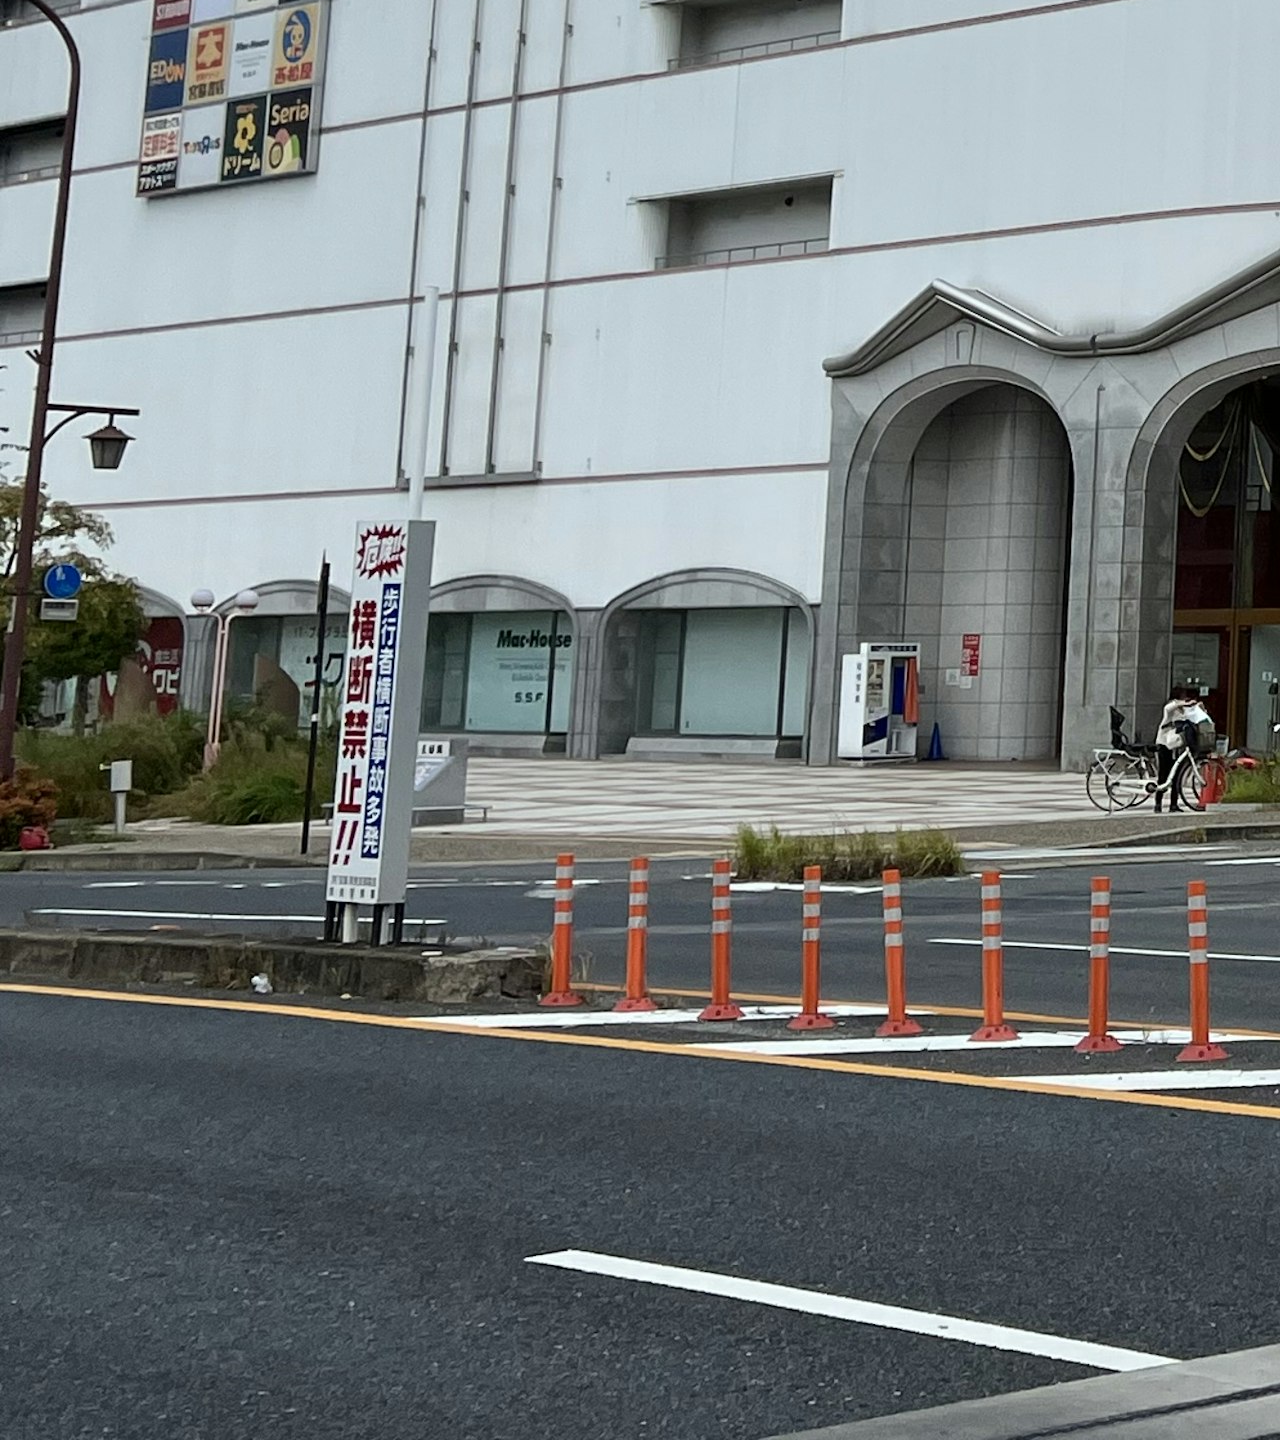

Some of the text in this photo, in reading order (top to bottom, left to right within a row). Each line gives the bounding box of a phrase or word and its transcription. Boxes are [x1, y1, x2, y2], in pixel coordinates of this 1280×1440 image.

[274, 62, 313, 85] 西松屋
[270, 98, 310, 126] Seria
[363, 587, 400, 855] 歩行者横断事故多発
